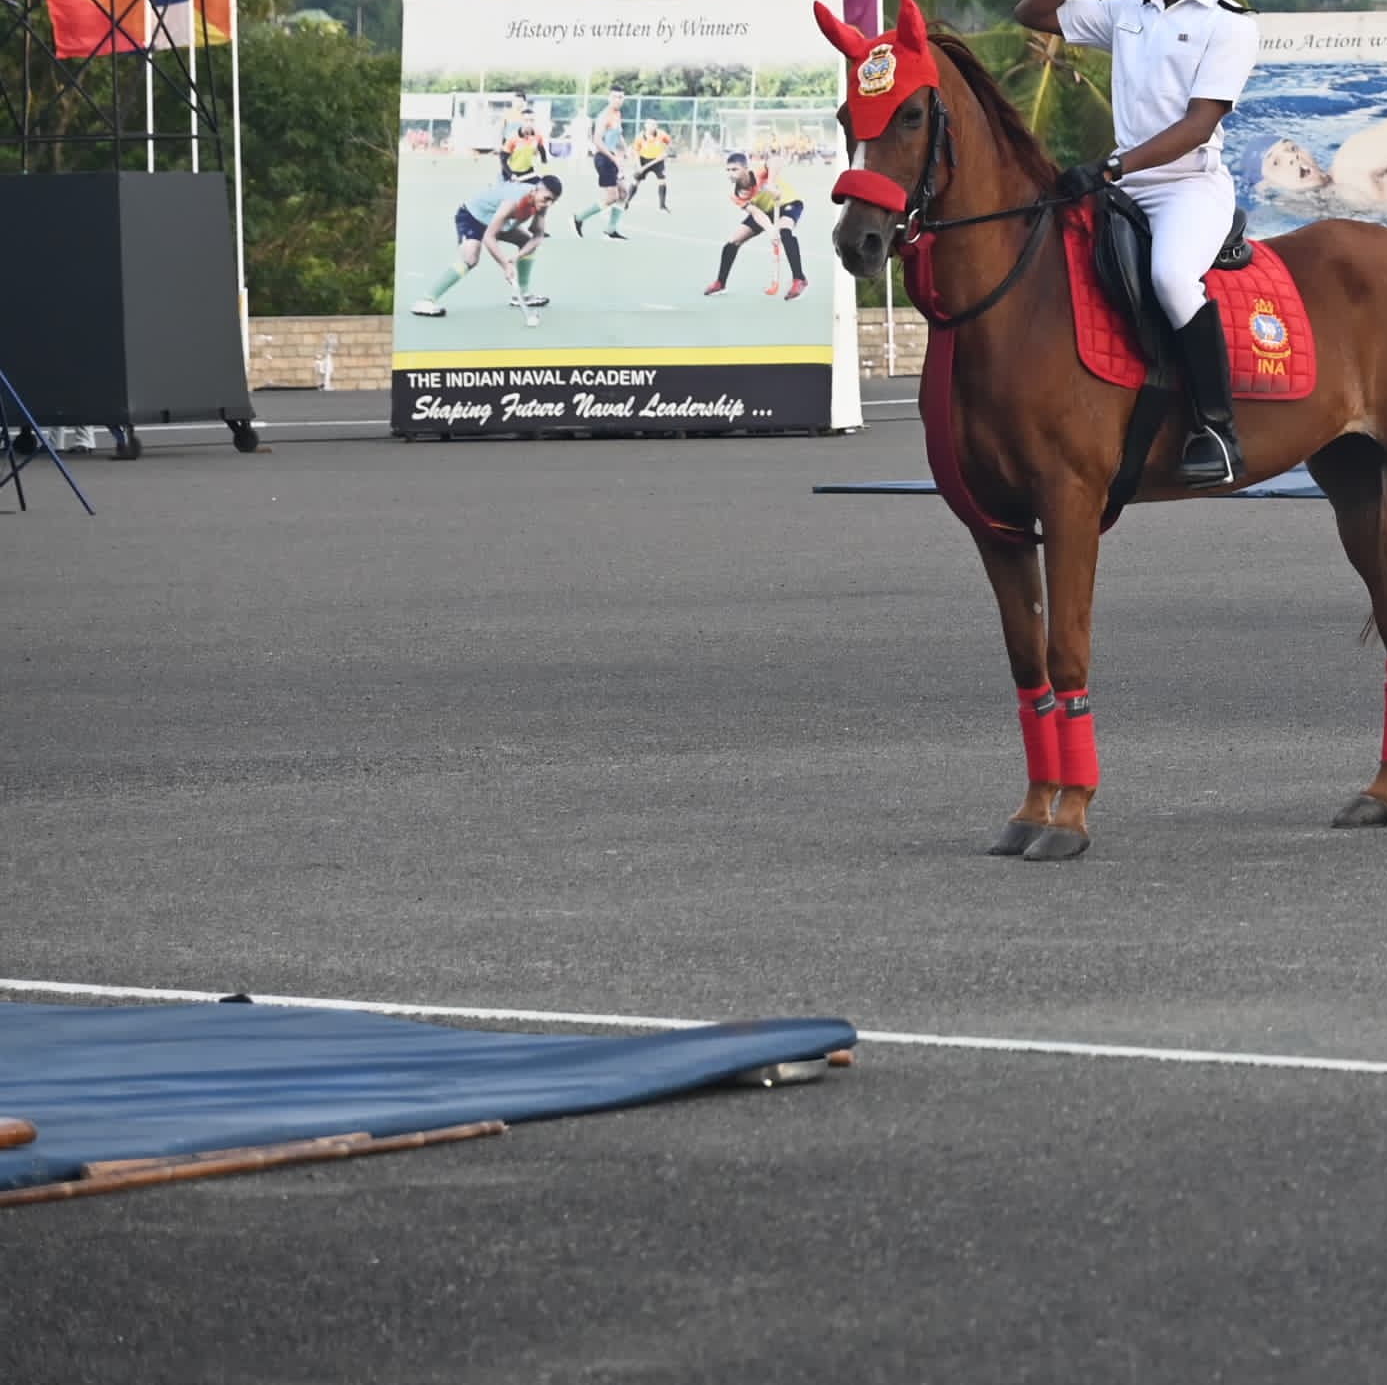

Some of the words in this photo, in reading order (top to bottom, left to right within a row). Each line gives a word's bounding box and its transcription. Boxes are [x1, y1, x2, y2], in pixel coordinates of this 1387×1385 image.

[506, 18, 568, 44] History
[573, 18, 586, 39] is
[590, 18, 650, 39] written
[657, 16, 676, 44] by
[680, 16, 750, 38] Winners
[1297, 32, 1361, 51] Action
[1257, 358, 1286, 375] INA
[408, 373, 442, 388] THE
[446, 371, 504, 388] INDIAN
[509, 370, 566, 387] NAVAL
[569, 369, 657, 386] ACADEMY
[411, 394, 493, 425] Shaping
[501, 393, 565, 422] Future
[572, 392, 634, 418] Naval
[638, 392, 745, 423] Leadership
